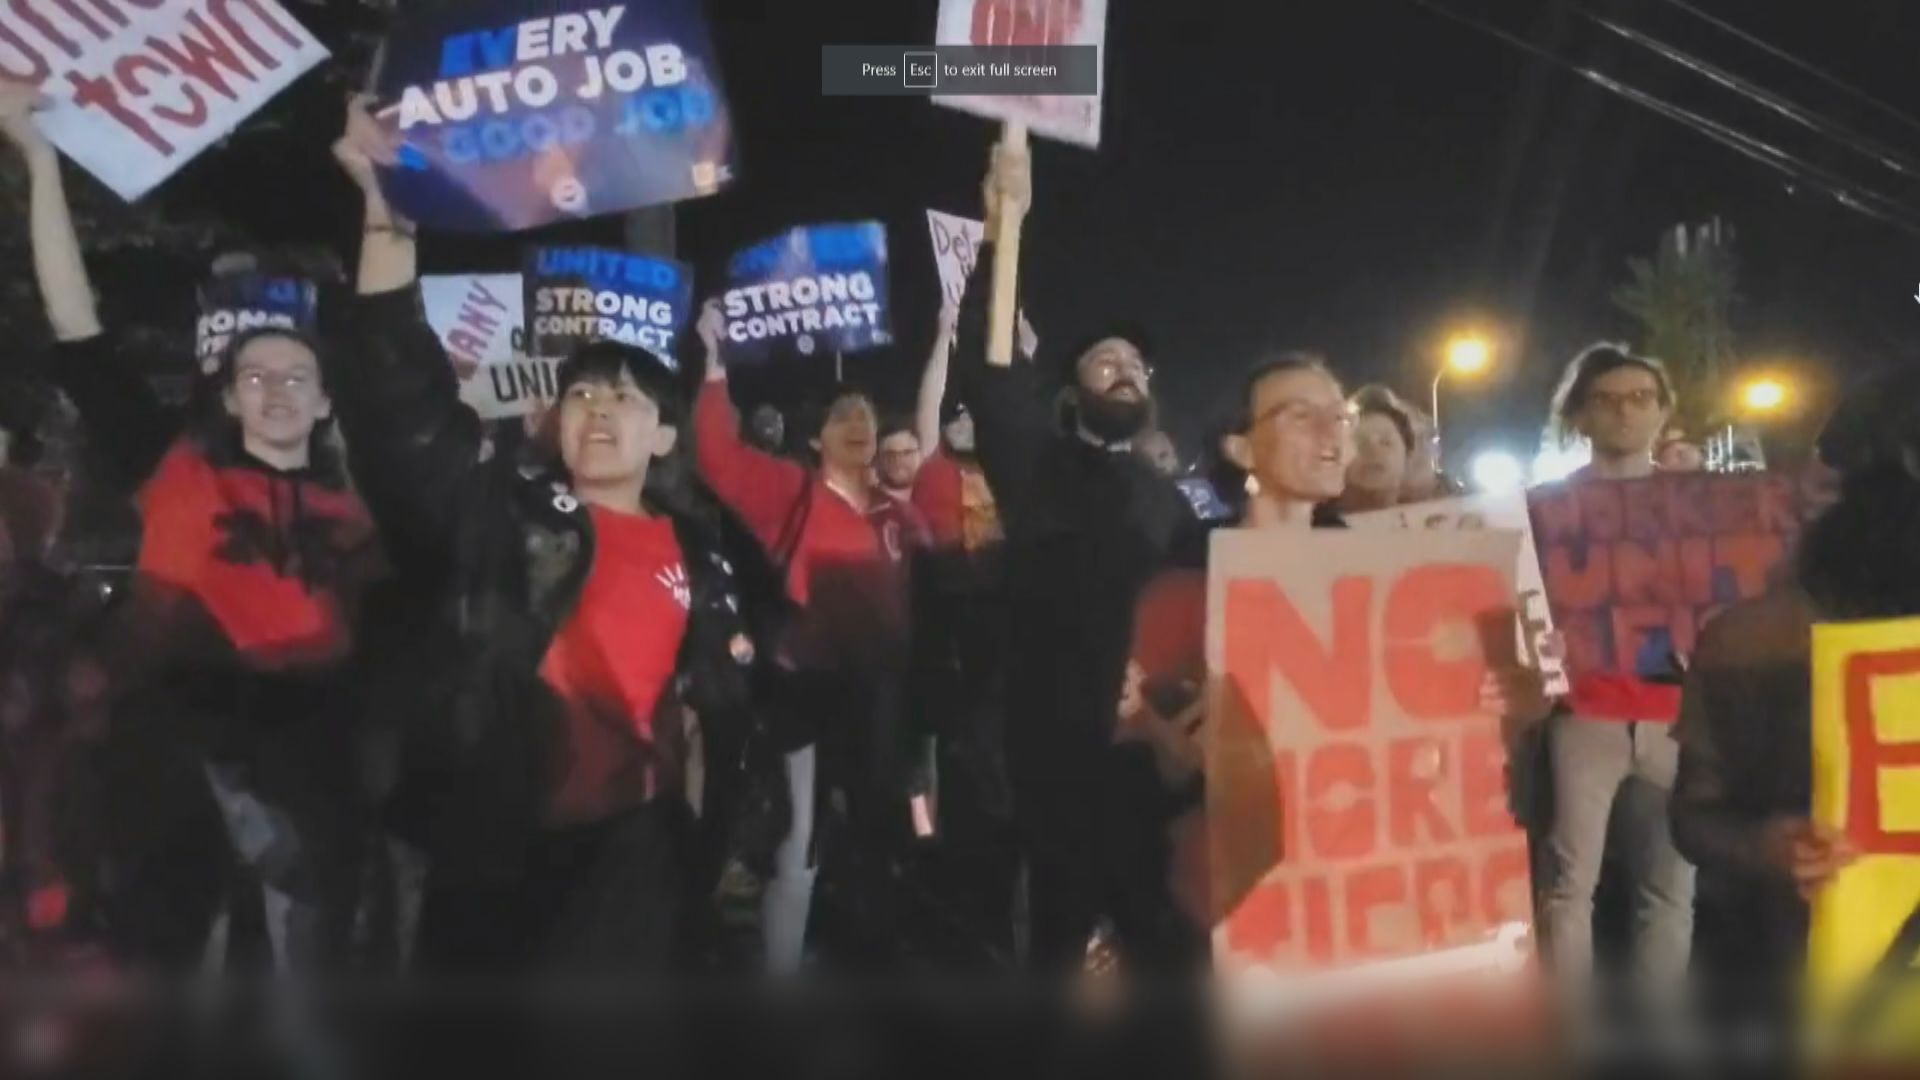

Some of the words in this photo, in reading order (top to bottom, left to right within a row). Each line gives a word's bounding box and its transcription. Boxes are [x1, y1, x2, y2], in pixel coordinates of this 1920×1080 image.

[438, 6, 627, 77] EVERY
[397, 66, 558, 131] AUTO
[575, 43, 688, 100] JOB
[535, 246, 679, 289] UNITED
[535, 286, 674, 326] STRONG
[723, 270, 876, 317] STRONG
[534, 316, 675, 349] CONTRACT
[728, 302, 882, 342] CONTRACT
[1223, 562, 1518, 732] NO
